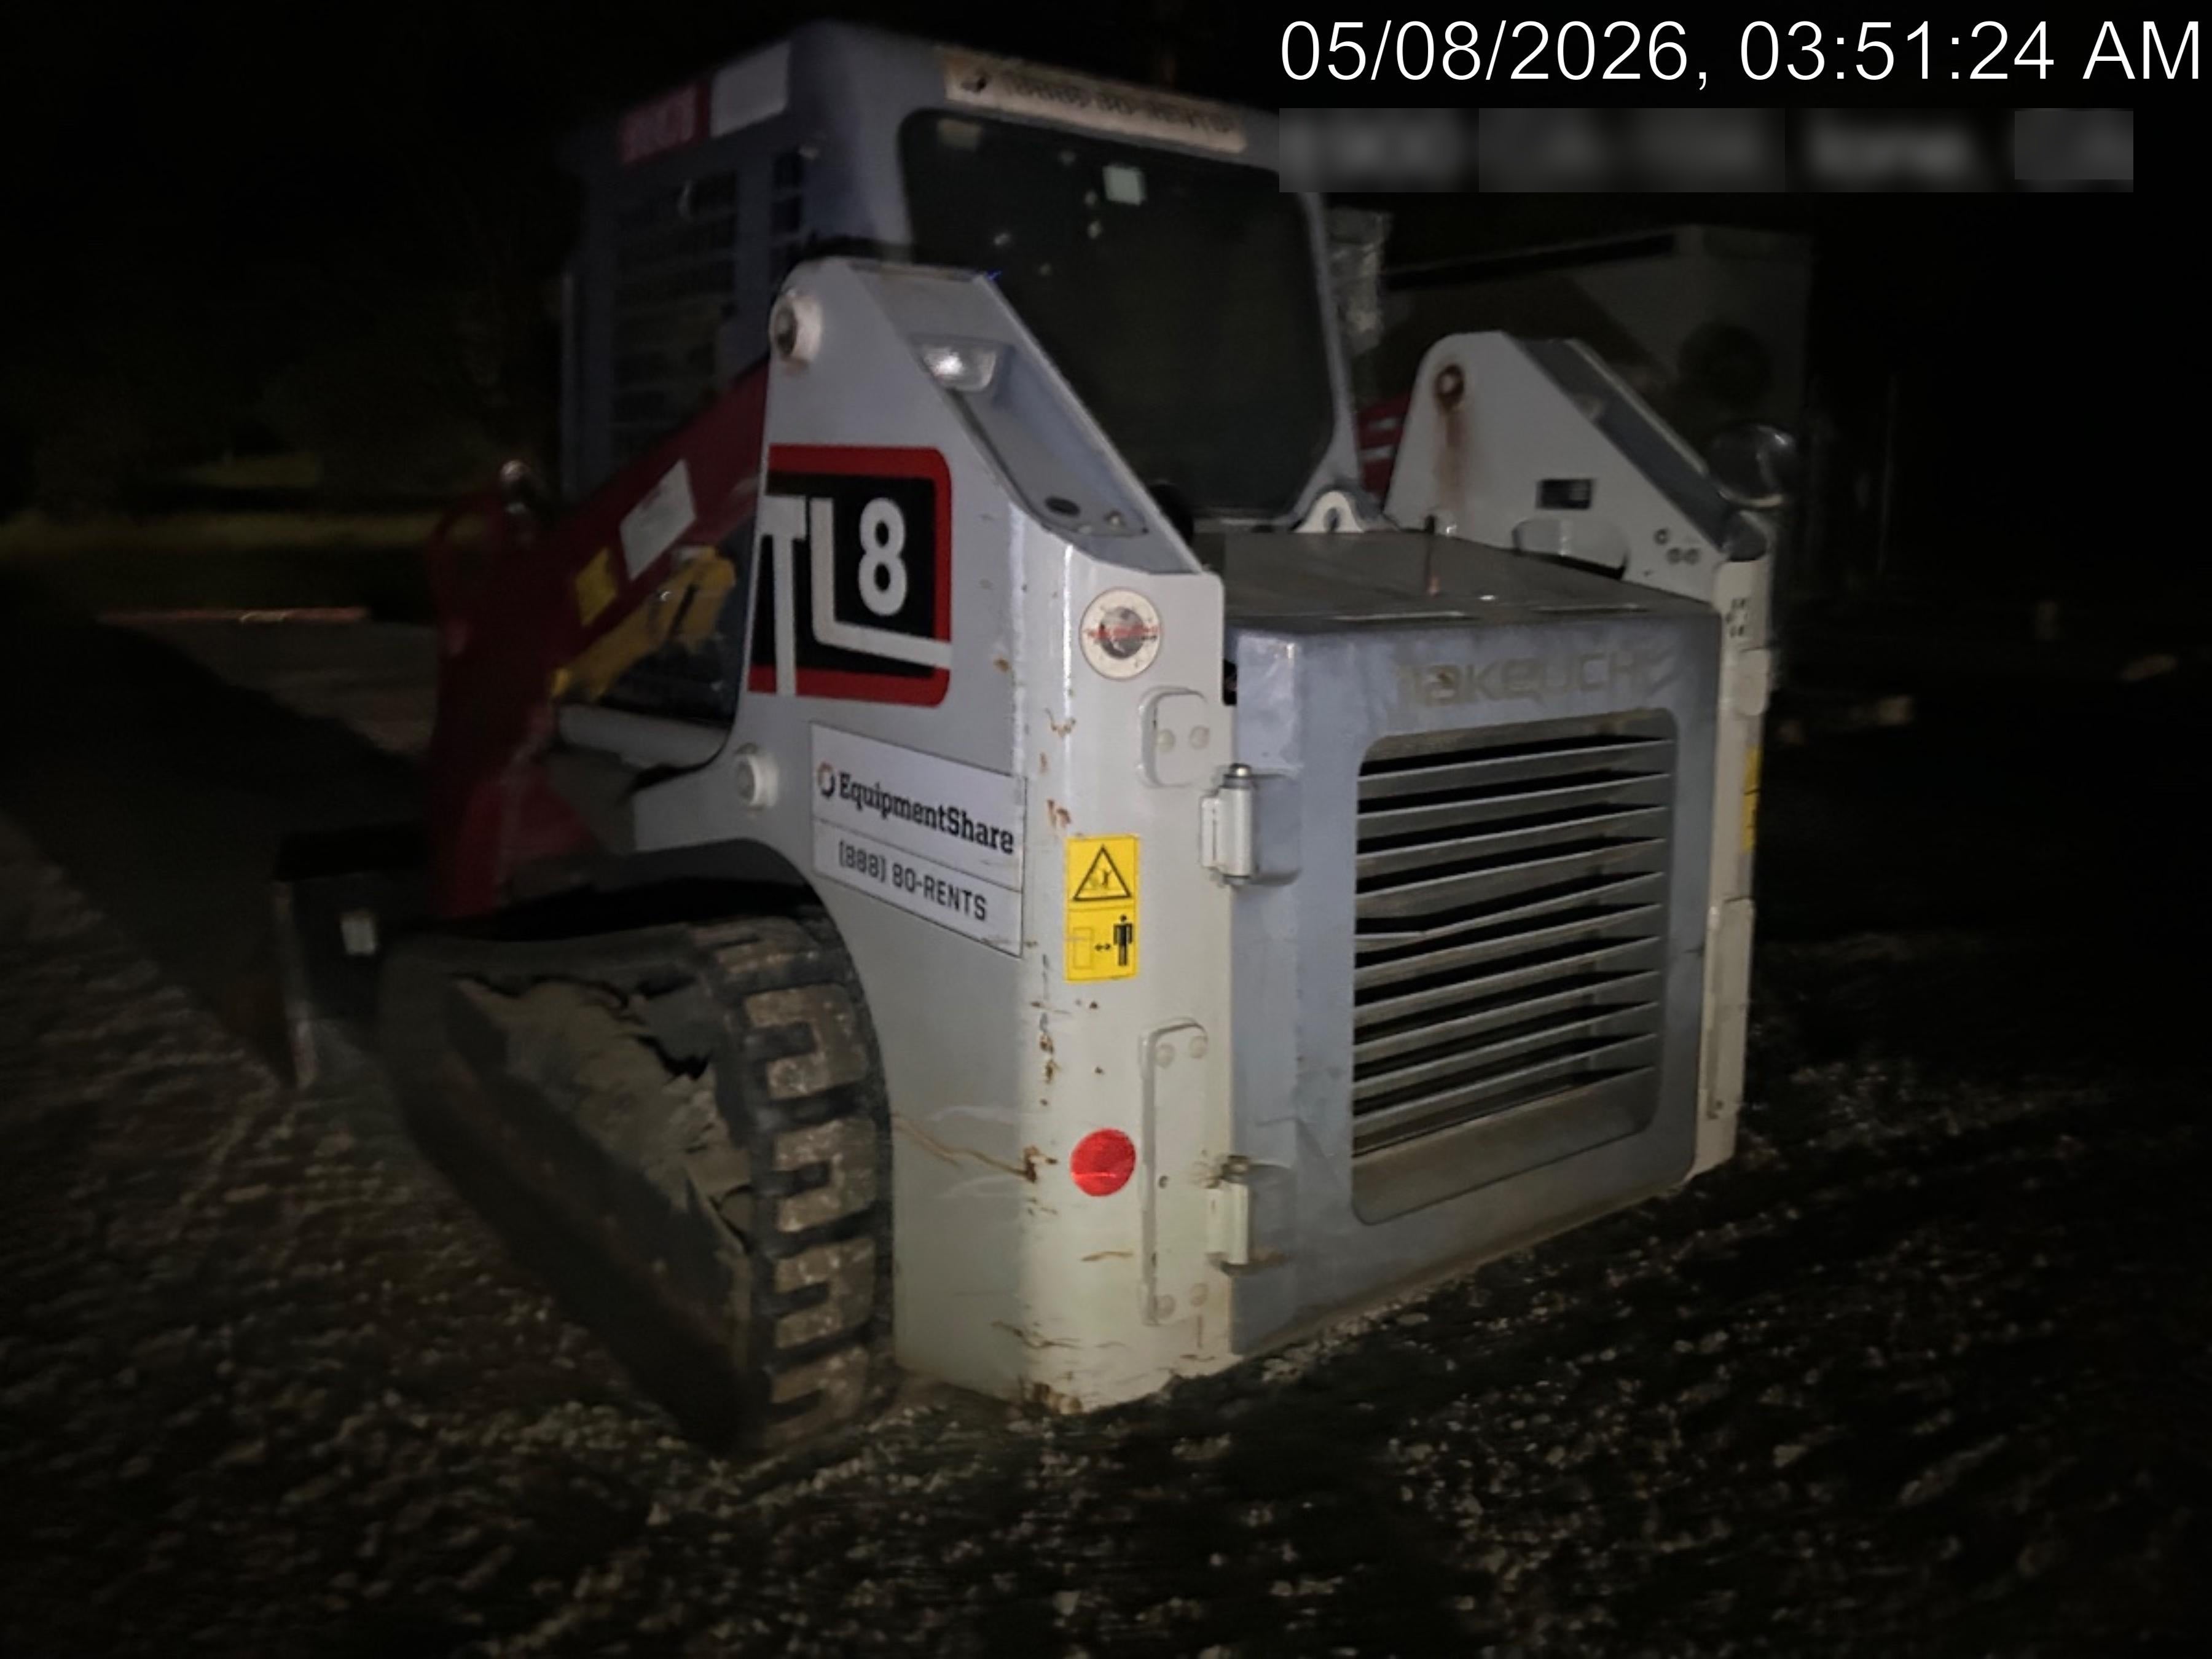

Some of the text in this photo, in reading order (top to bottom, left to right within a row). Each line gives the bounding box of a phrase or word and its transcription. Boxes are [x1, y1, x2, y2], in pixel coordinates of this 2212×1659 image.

[757, 494, 952, 697] TL8
[838, 772, 1014, 854] EquipmentShare
[838, 839, 987, 920] (888) 80-RENTS
